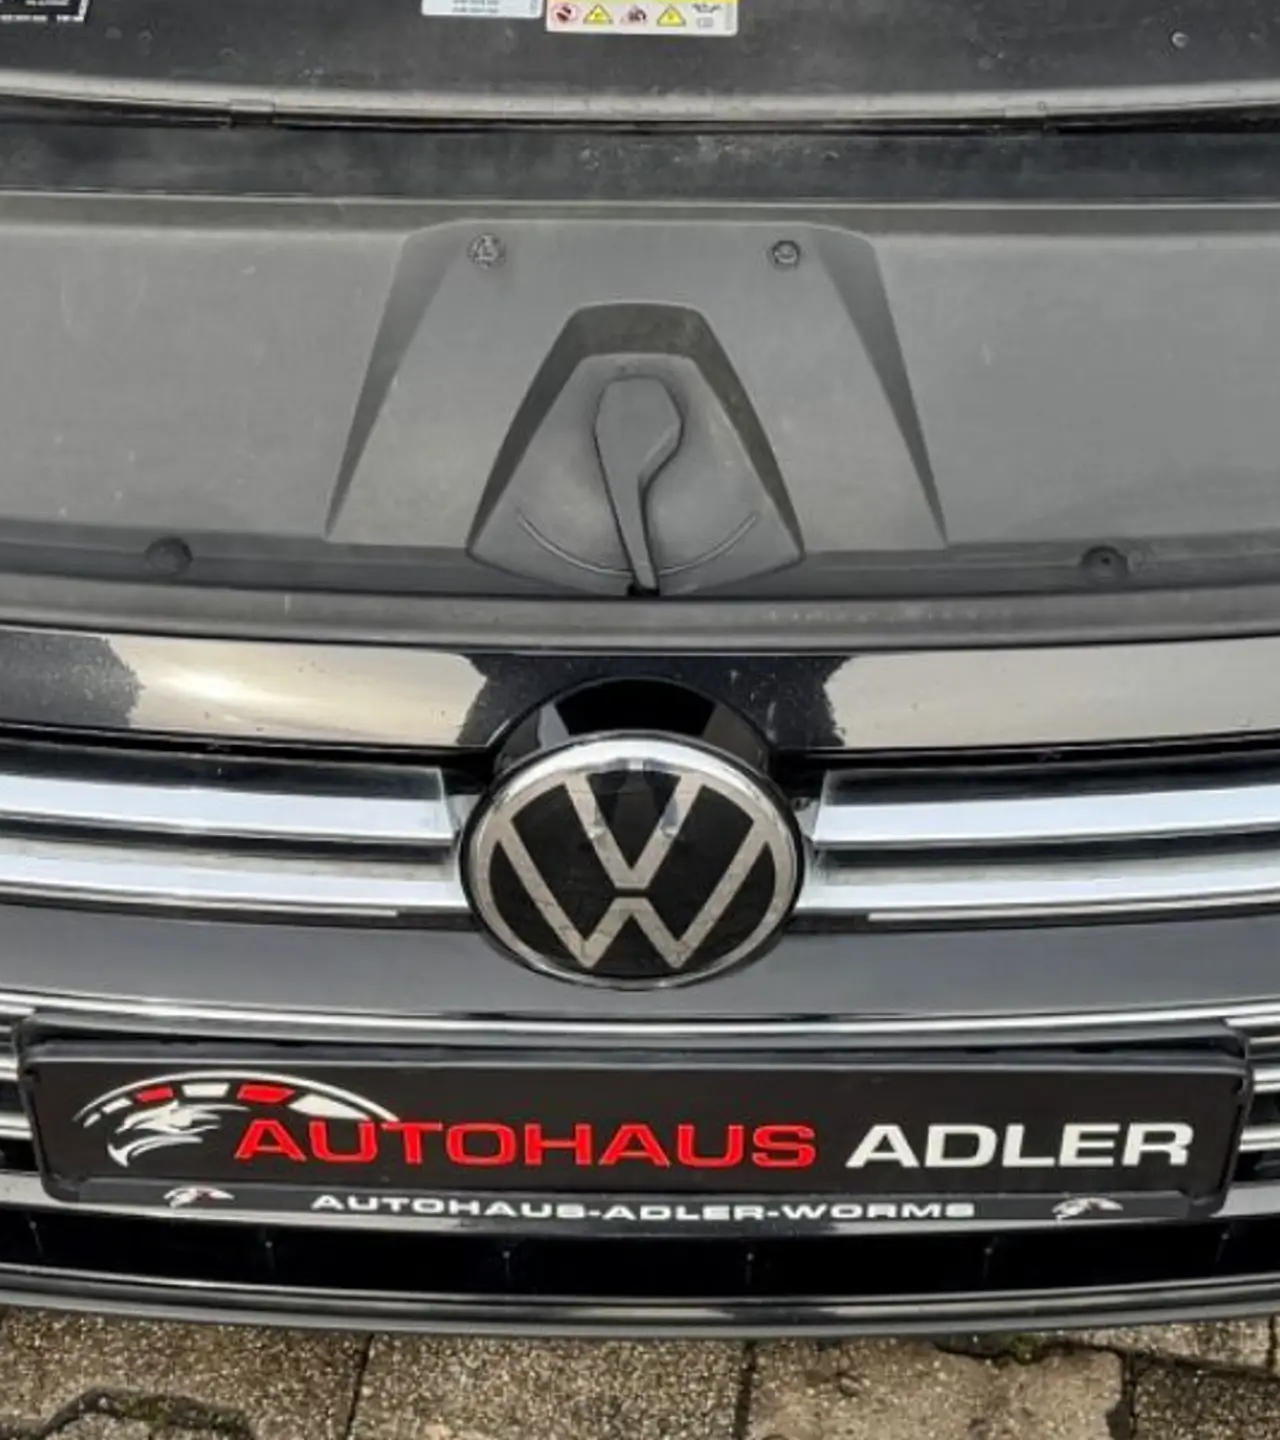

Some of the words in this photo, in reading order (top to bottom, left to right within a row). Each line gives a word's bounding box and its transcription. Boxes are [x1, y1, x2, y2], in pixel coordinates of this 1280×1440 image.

[484, 766, 784, 970] VW
[235, 1118, 817, 1169] AUTOHAUS
[845, 1122, 1195, 1168] ADLER
[310, 1194, 976, 1221] AUTOHAUS-ADLER-WORMS
